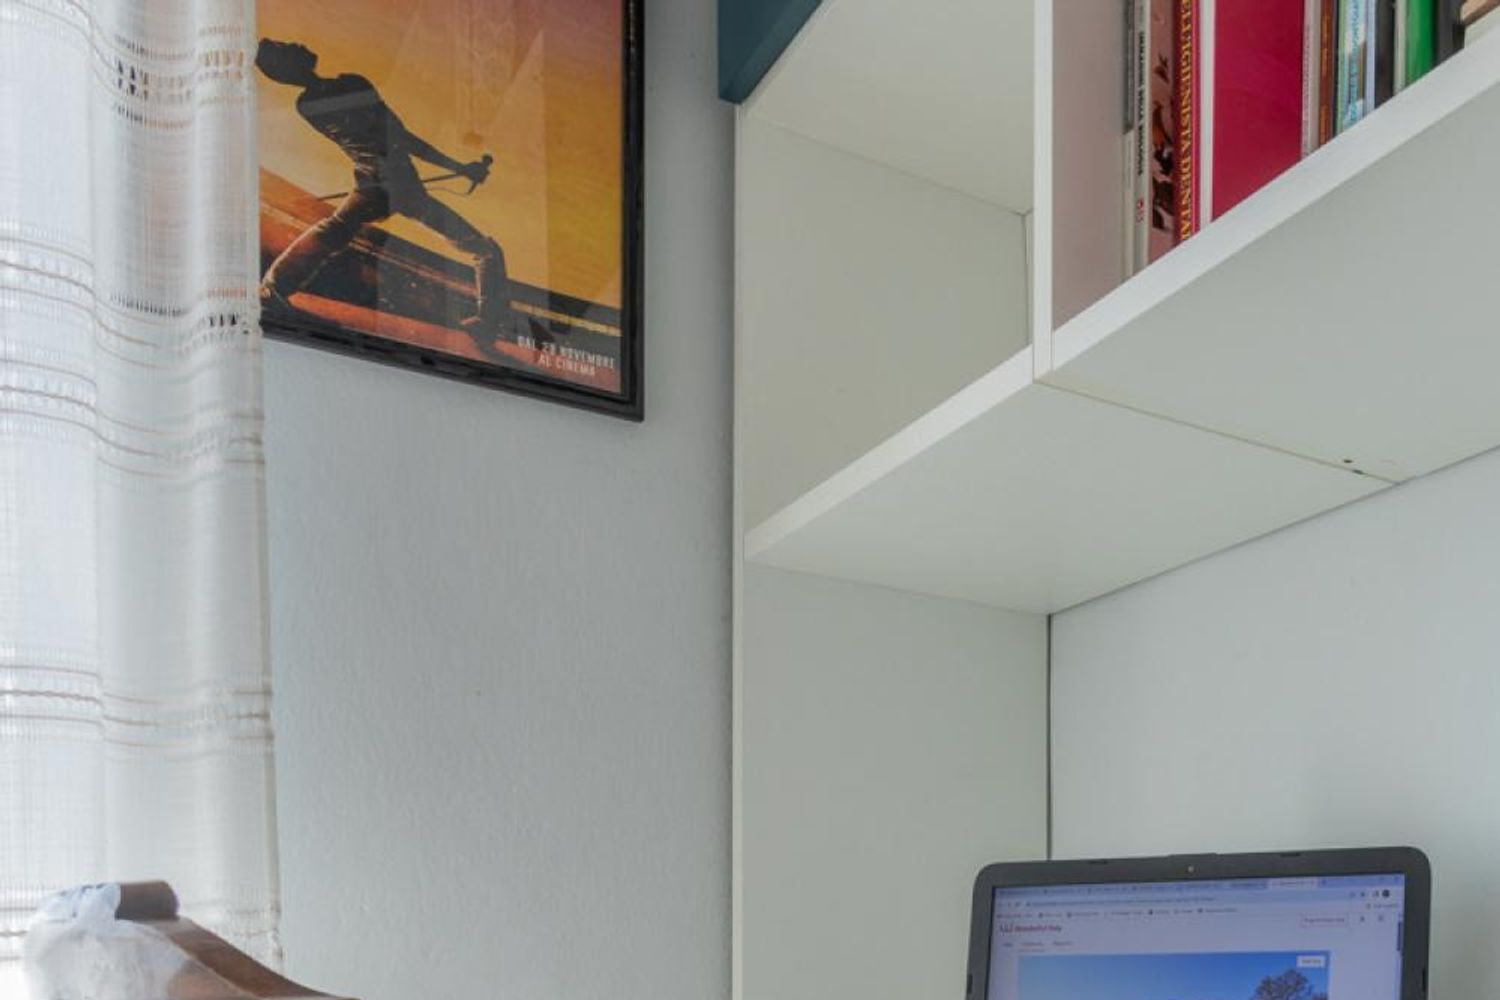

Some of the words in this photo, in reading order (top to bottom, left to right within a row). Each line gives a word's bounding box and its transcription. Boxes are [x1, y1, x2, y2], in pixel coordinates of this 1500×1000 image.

[538, 353, 552, 368] AL
[555, 356, 596, 376] CINEMA
[559, 345, 615, 369] NOVEMBRE
